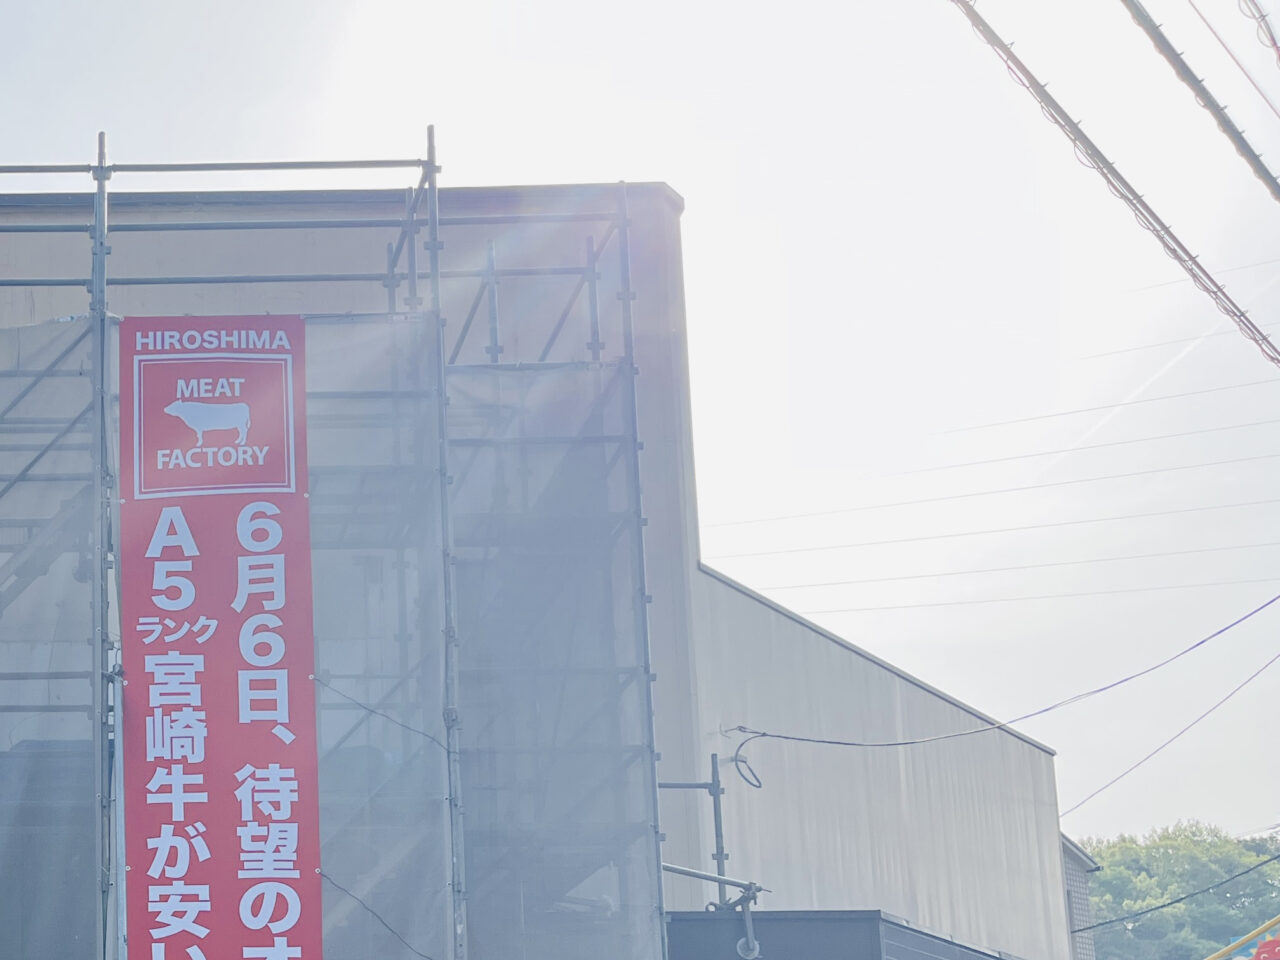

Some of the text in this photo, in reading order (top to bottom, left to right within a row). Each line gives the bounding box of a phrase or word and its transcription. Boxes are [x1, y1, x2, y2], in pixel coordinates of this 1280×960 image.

[136, 330, 291, 350] HIROSHIMA
[176, 378, 245, 399] MEAT
[157, 446, 269, 469] FACTORY
